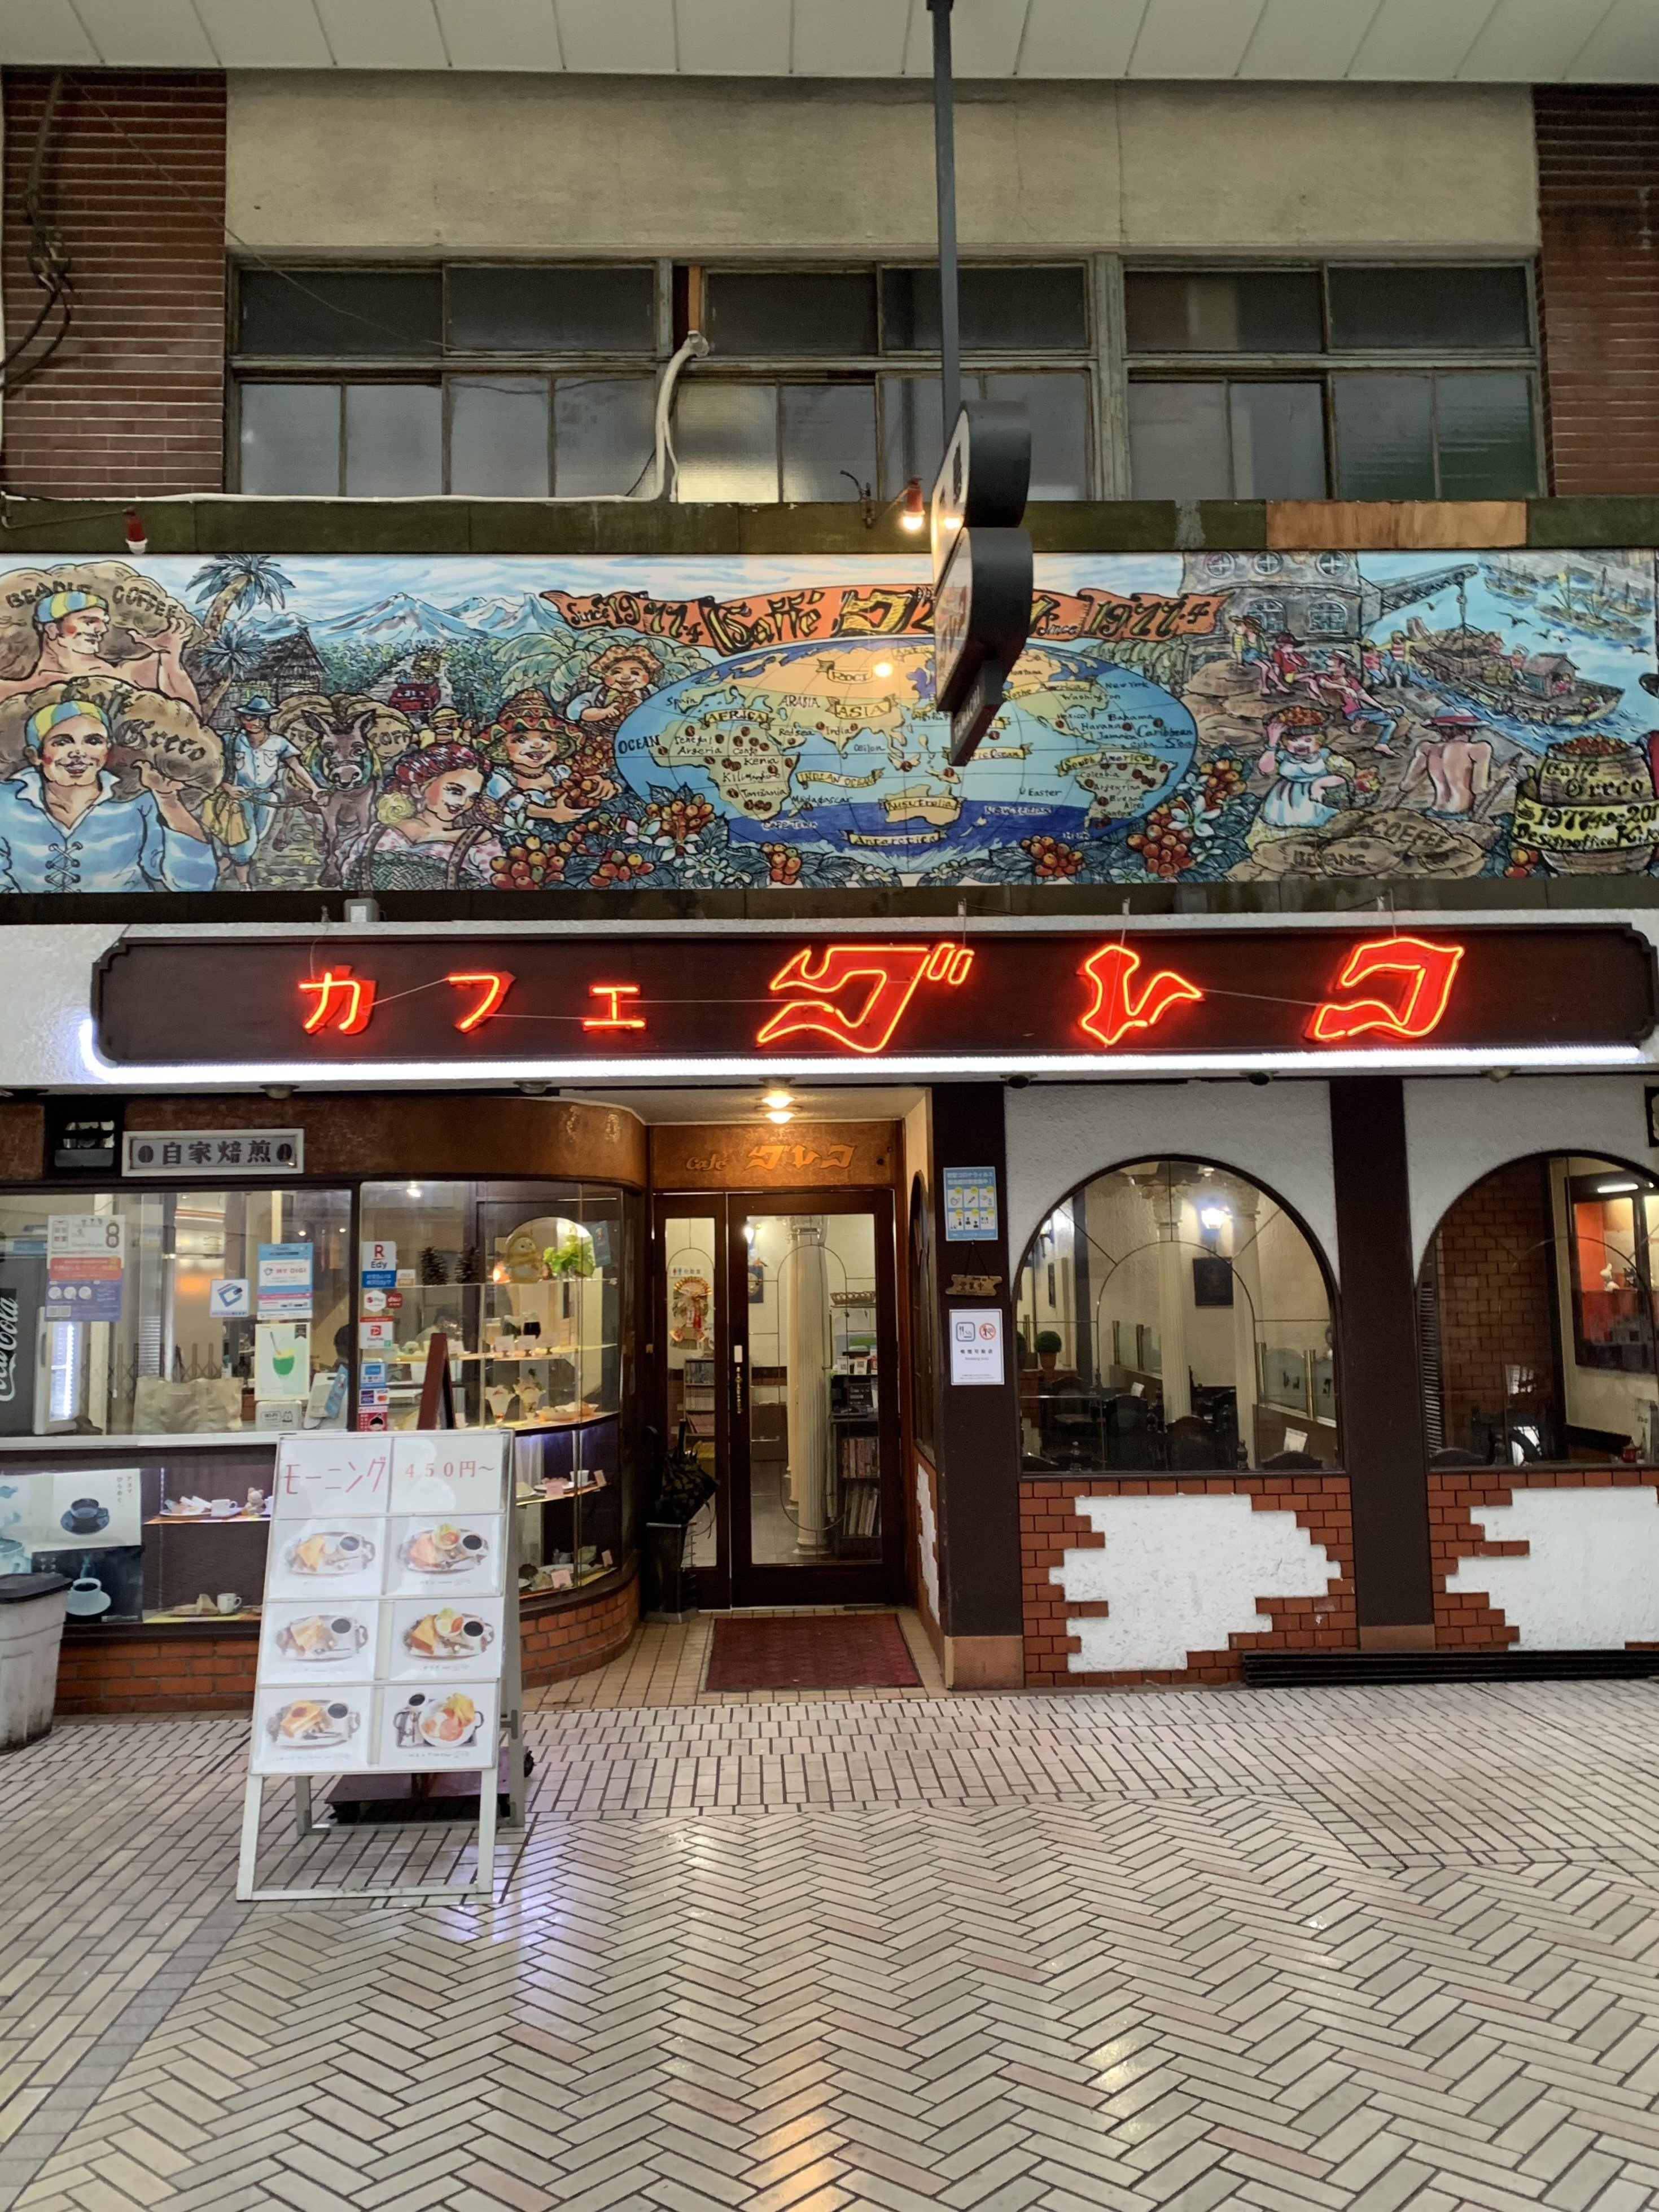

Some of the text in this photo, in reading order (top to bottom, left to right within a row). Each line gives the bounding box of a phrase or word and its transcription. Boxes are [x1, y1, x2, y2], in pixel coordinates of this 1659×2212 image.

[112, 585, 178, 617] COFFEE
[566, 602, 610, 625] Since
[1036, 612, 1078, 637] Since
[778, 694, 820, 708] ARABIA
[1060, 693, 1121, 703] Washington
[707, 709, 764, 723] AFRICA
[835, 705, 886, 718] ASIA
[826, 724, 851, 735] India
[1080, 722, 1122, 732] Havana
[114, 719, 207, 762] Greco
[618, 734, 660, 754] OCEAN
[1100, 751, 1150, 763] America
[799, 772, 841, 783] INDIAN
[1028, 789, 1062, 797] Easter
[854, 835, 937, 846] Antarctica
[299, 965, 647, 1035] カフェ
[756, 937, 1466, 1054] グレコ
[161, 1140, 272, 1165] 自家焙煎
[745, 1143, 857, 1171] グレコ
[370, 1261, 388, 1269] Edy
[283, 1456, 387, 1495] モーニング
